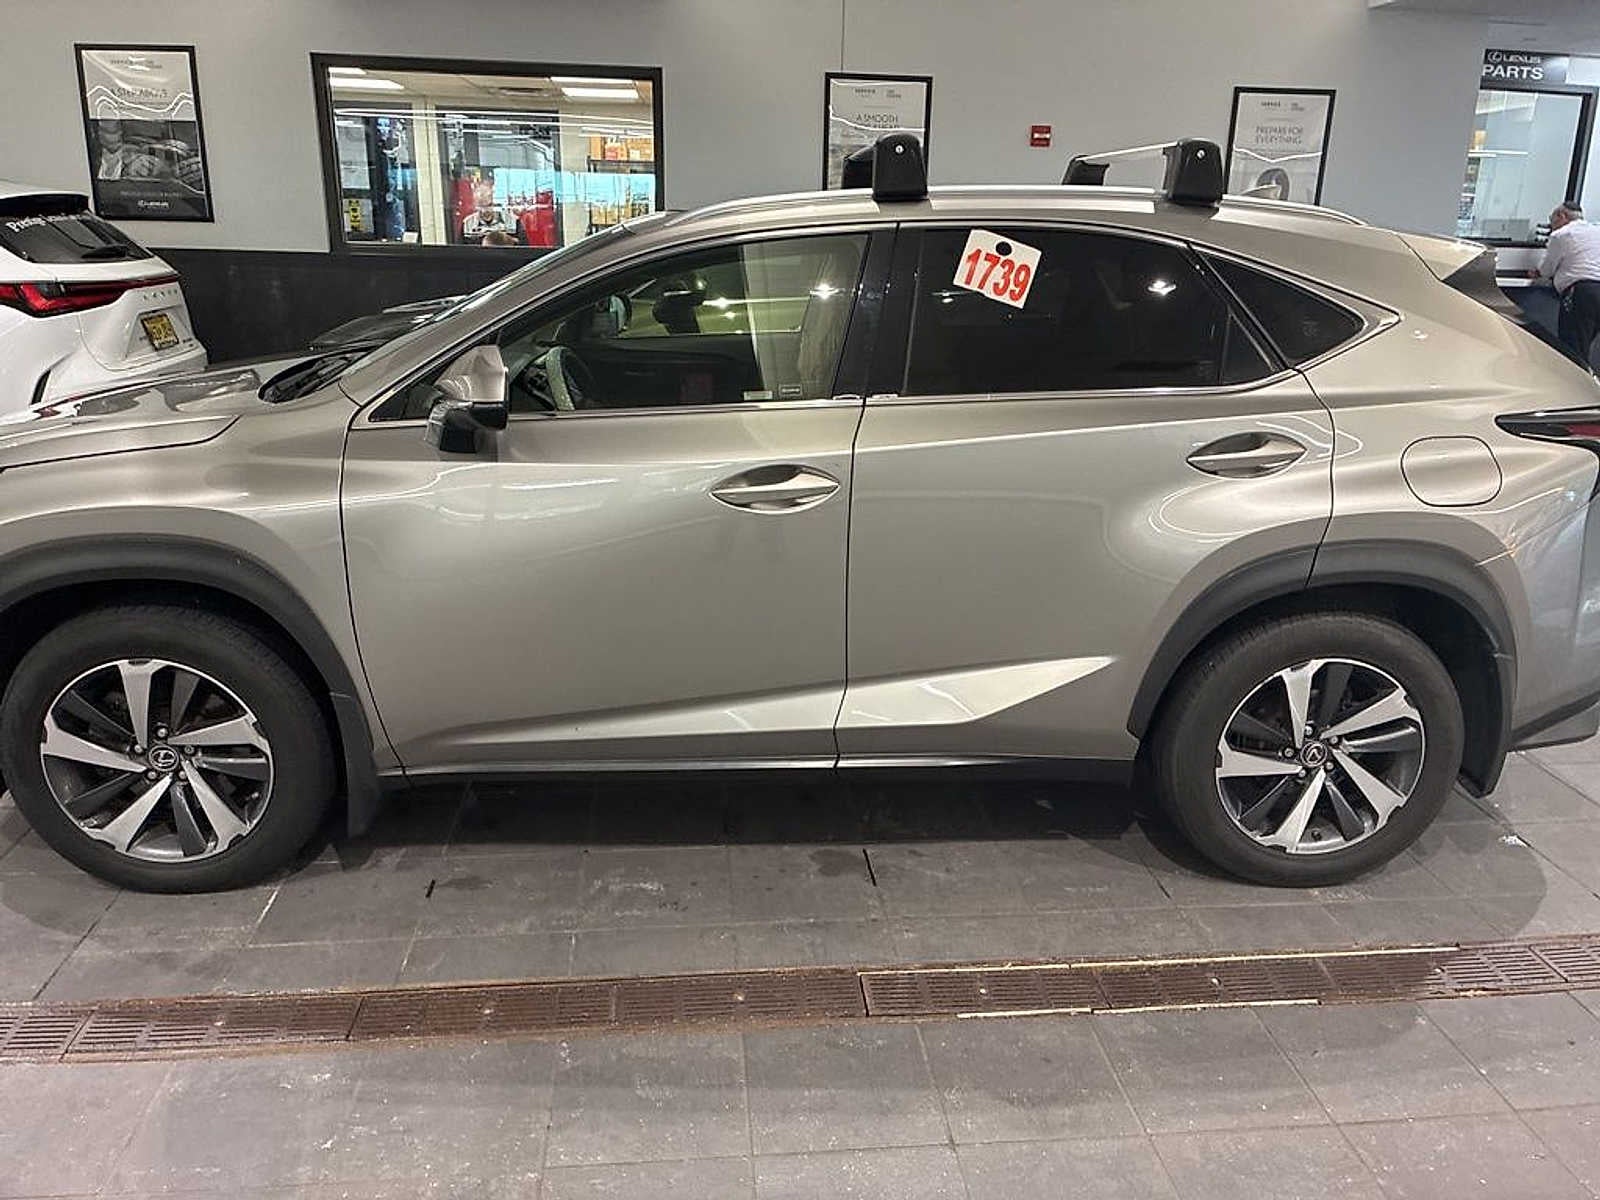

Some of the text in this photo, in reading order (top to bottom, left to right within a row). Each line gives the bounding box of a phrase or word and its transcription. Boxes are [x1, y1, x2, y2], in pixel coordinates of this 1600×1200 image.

[1503, 54, 1542, 64] LEXUS
[1481, 64, 1544, 80] PARTS
[964, 248, 1031, 302] 1739
